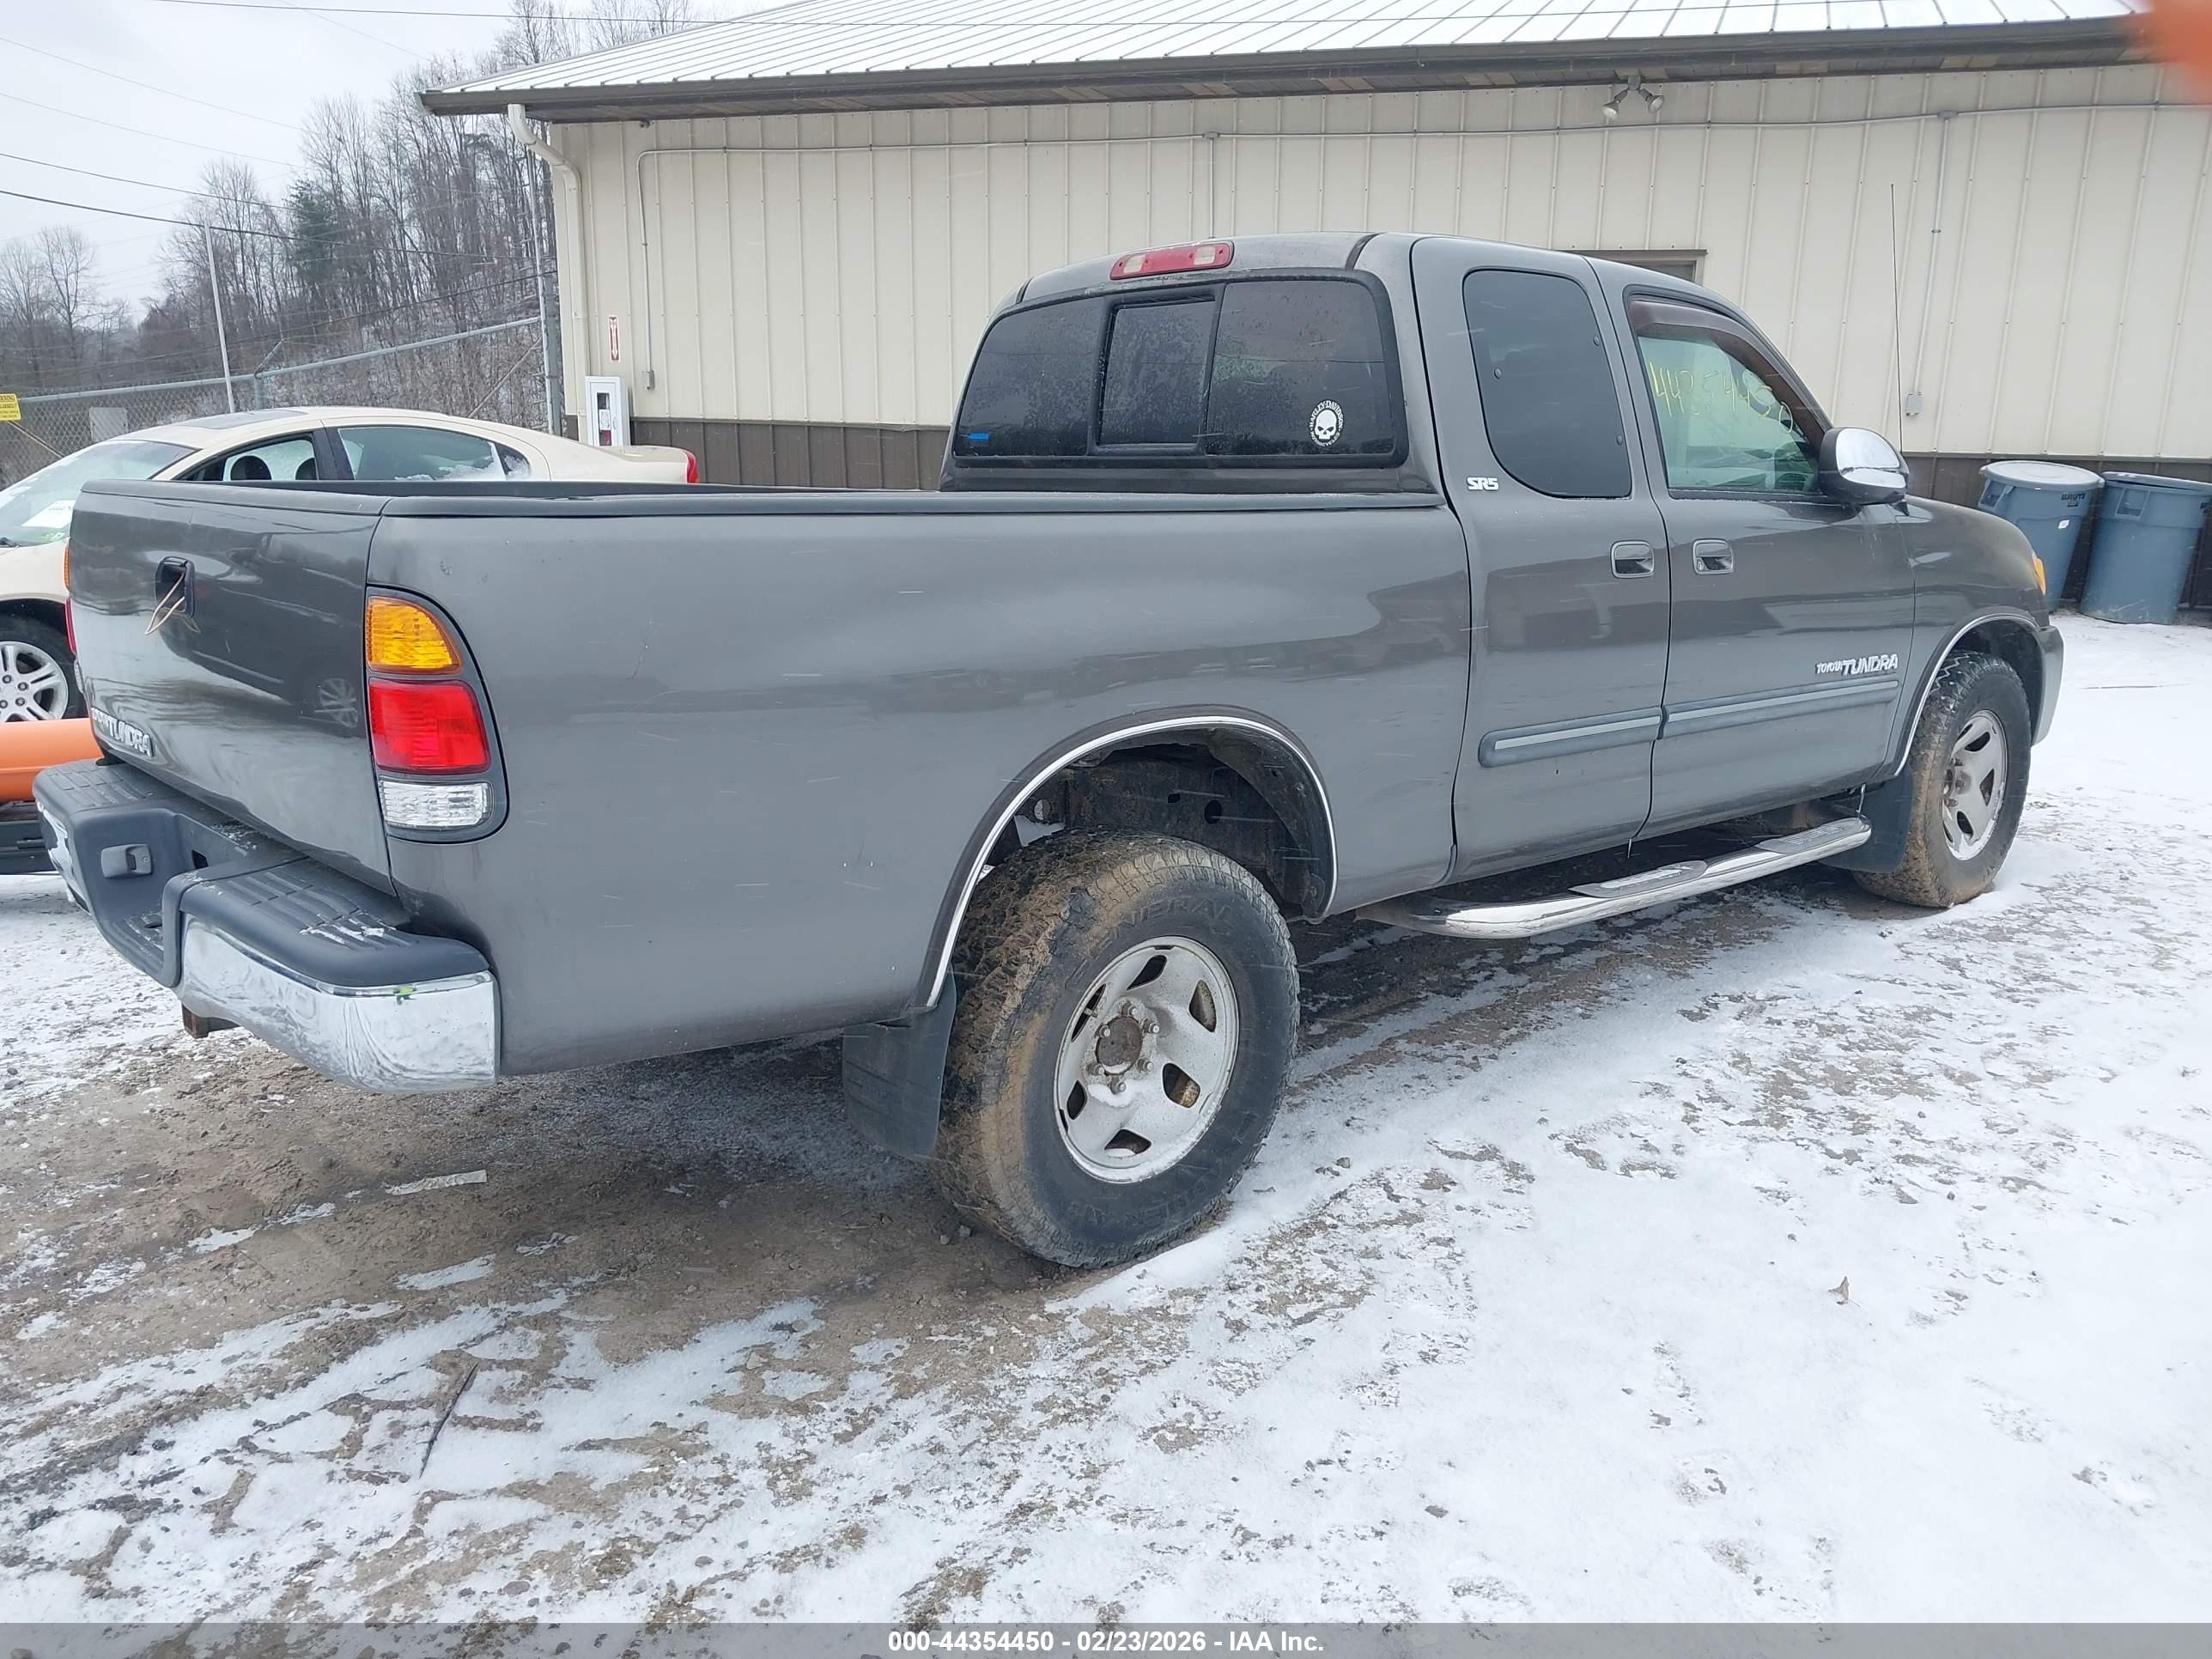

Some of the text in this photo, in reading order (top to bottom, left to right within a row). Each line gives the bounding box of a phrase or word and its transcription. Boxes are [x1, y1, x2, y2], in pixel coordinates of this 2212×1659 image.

[1467, 477, 1499, 490] SR5
[1842, 653, 1899, 676] TUNDRA
[108, 715, 151, 757] TUNDRA
